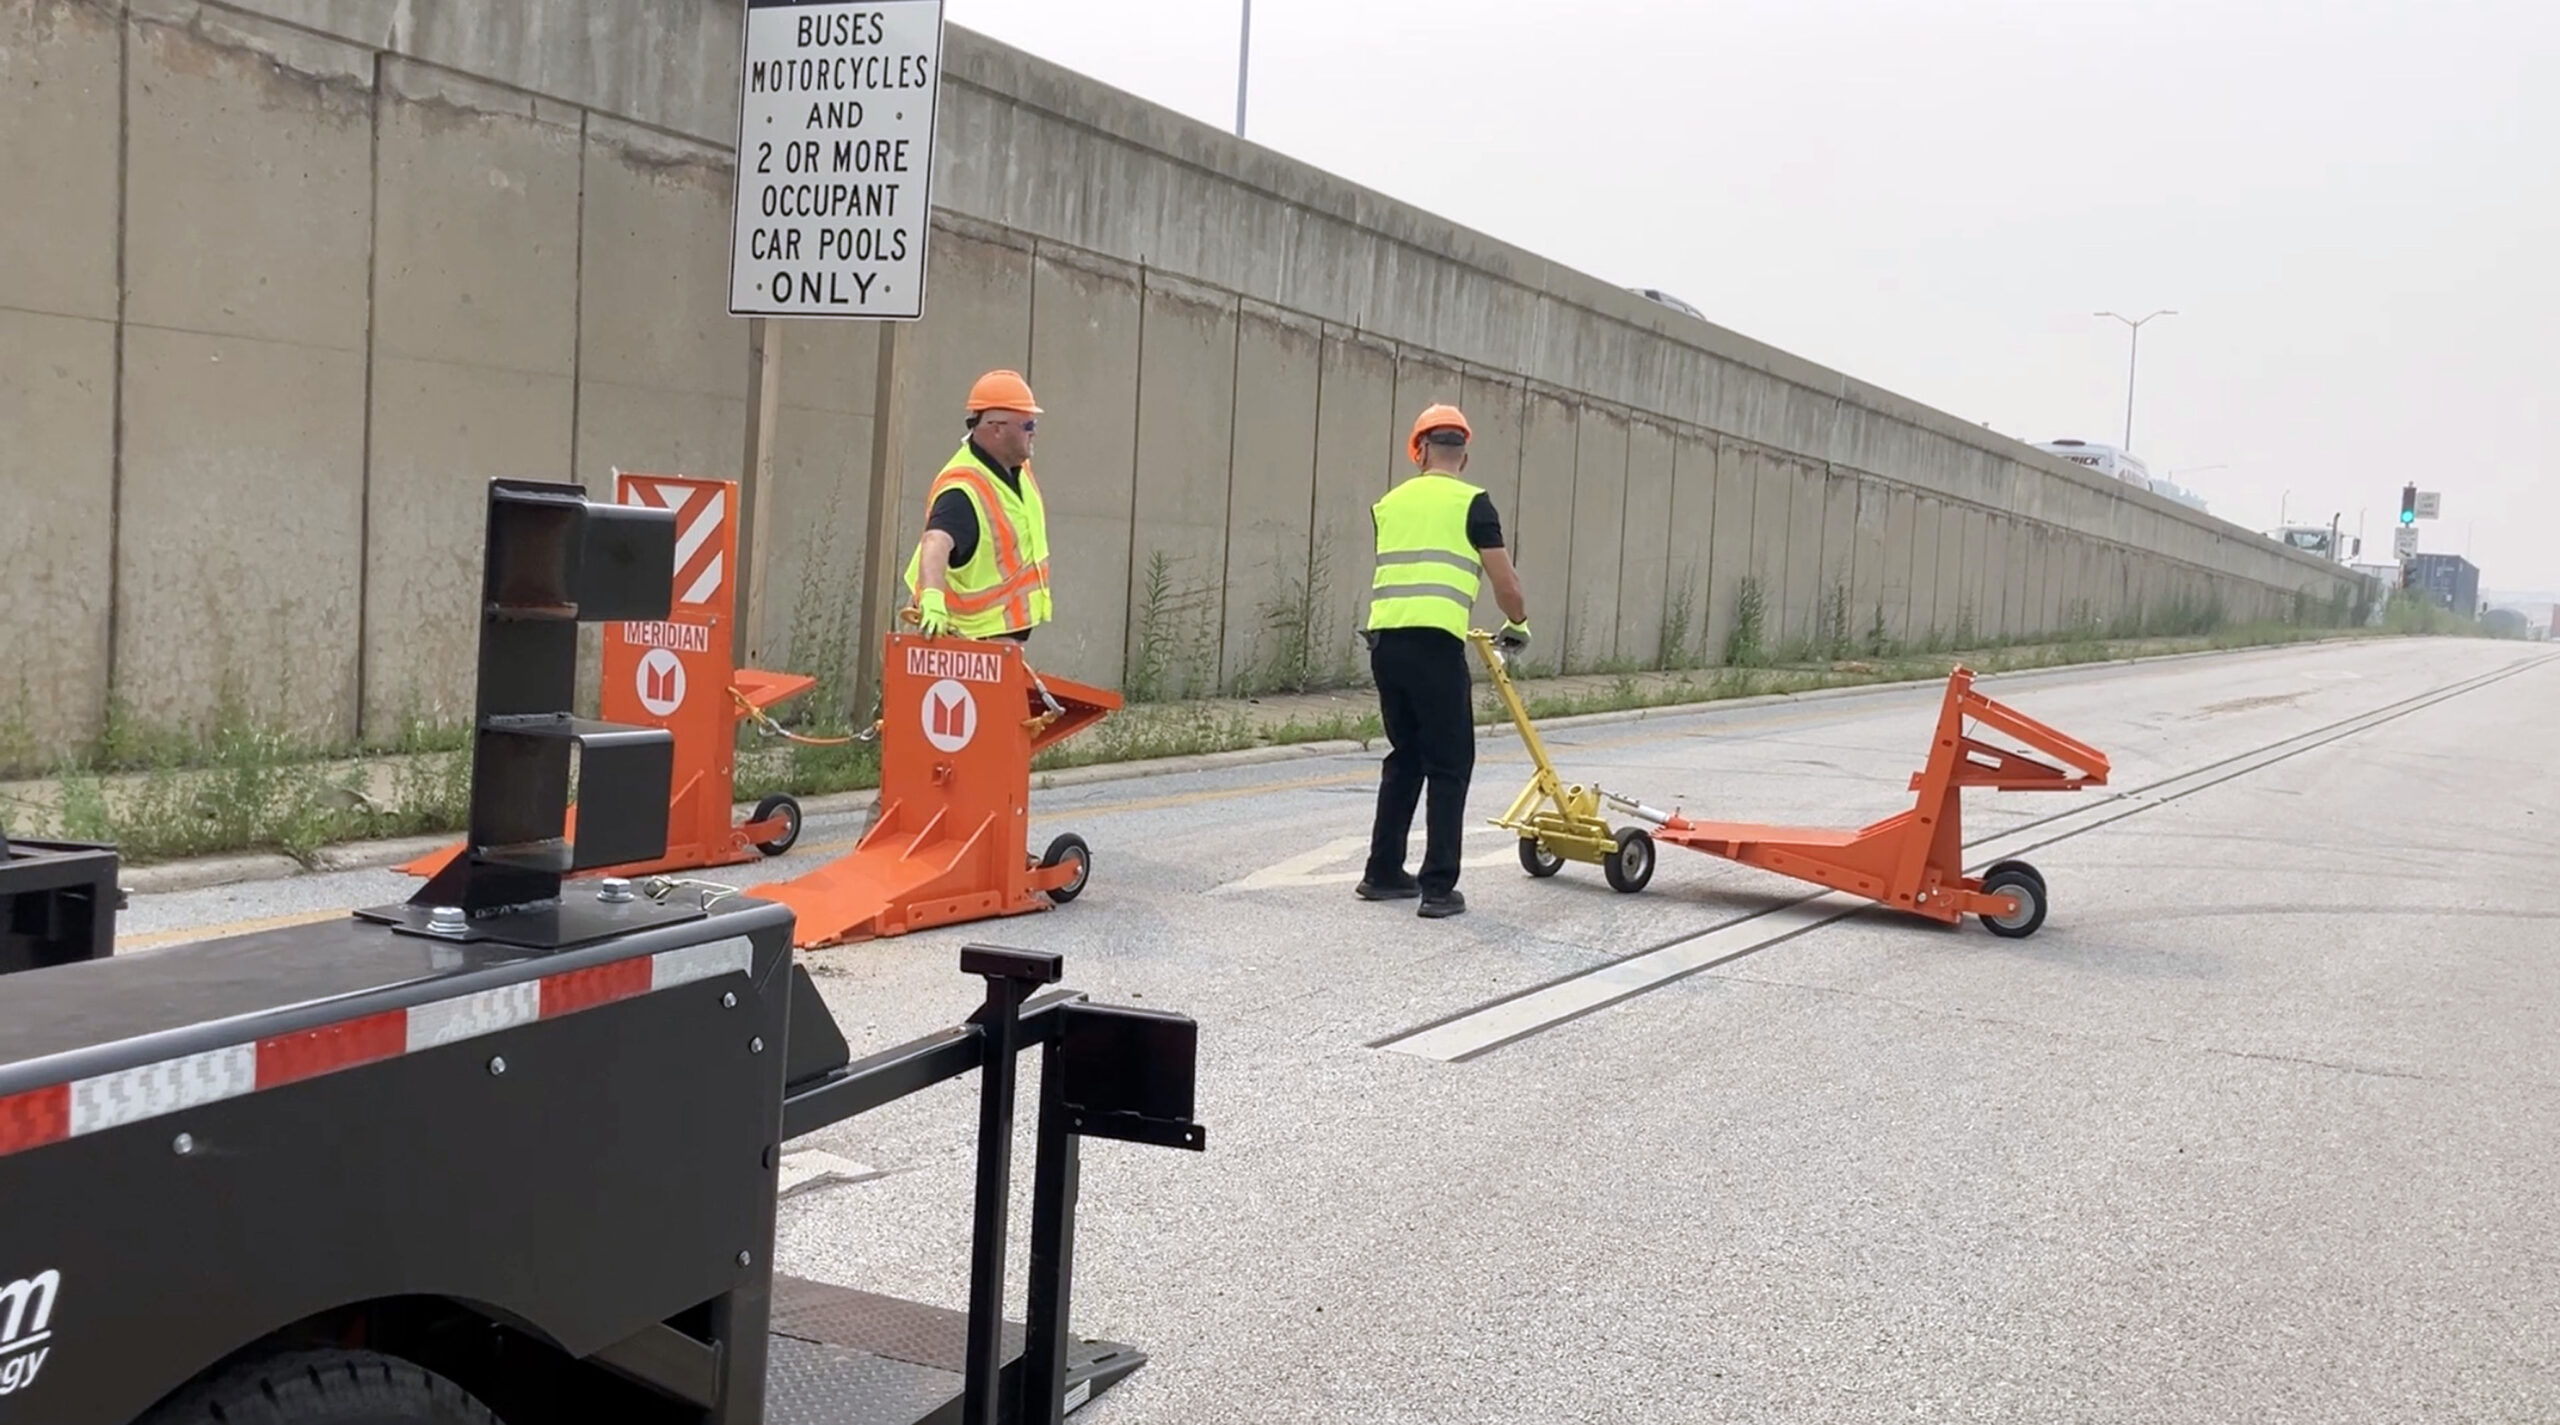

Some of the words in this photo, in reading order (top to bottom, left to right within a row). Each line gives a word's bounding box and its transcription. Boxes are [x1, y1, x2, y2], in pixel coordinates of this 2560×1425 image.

[797, 12, 884, 48] BUSES
[751, 55, 928, 93] MOTORCYCLES
[806, 101, 863, 129] AND
[757, 142, 772, 173] 2
[786, 141, 820, 173] OR
[833, 140, 910, 173] MORE
[761, 184, 900, 217] OCCUPANT
[751, 228, 801, 261] CAR
[819, 228, 907, 261] POOLS
[772, 271, 877, 304] ONLY
[2064, 455, 2101, 467] RICK
[626, 621, 706, 650] MERIDIAN
[910, 648, 998, 681] MERIDIAN
[0, 1347, 50, 1395] gy
